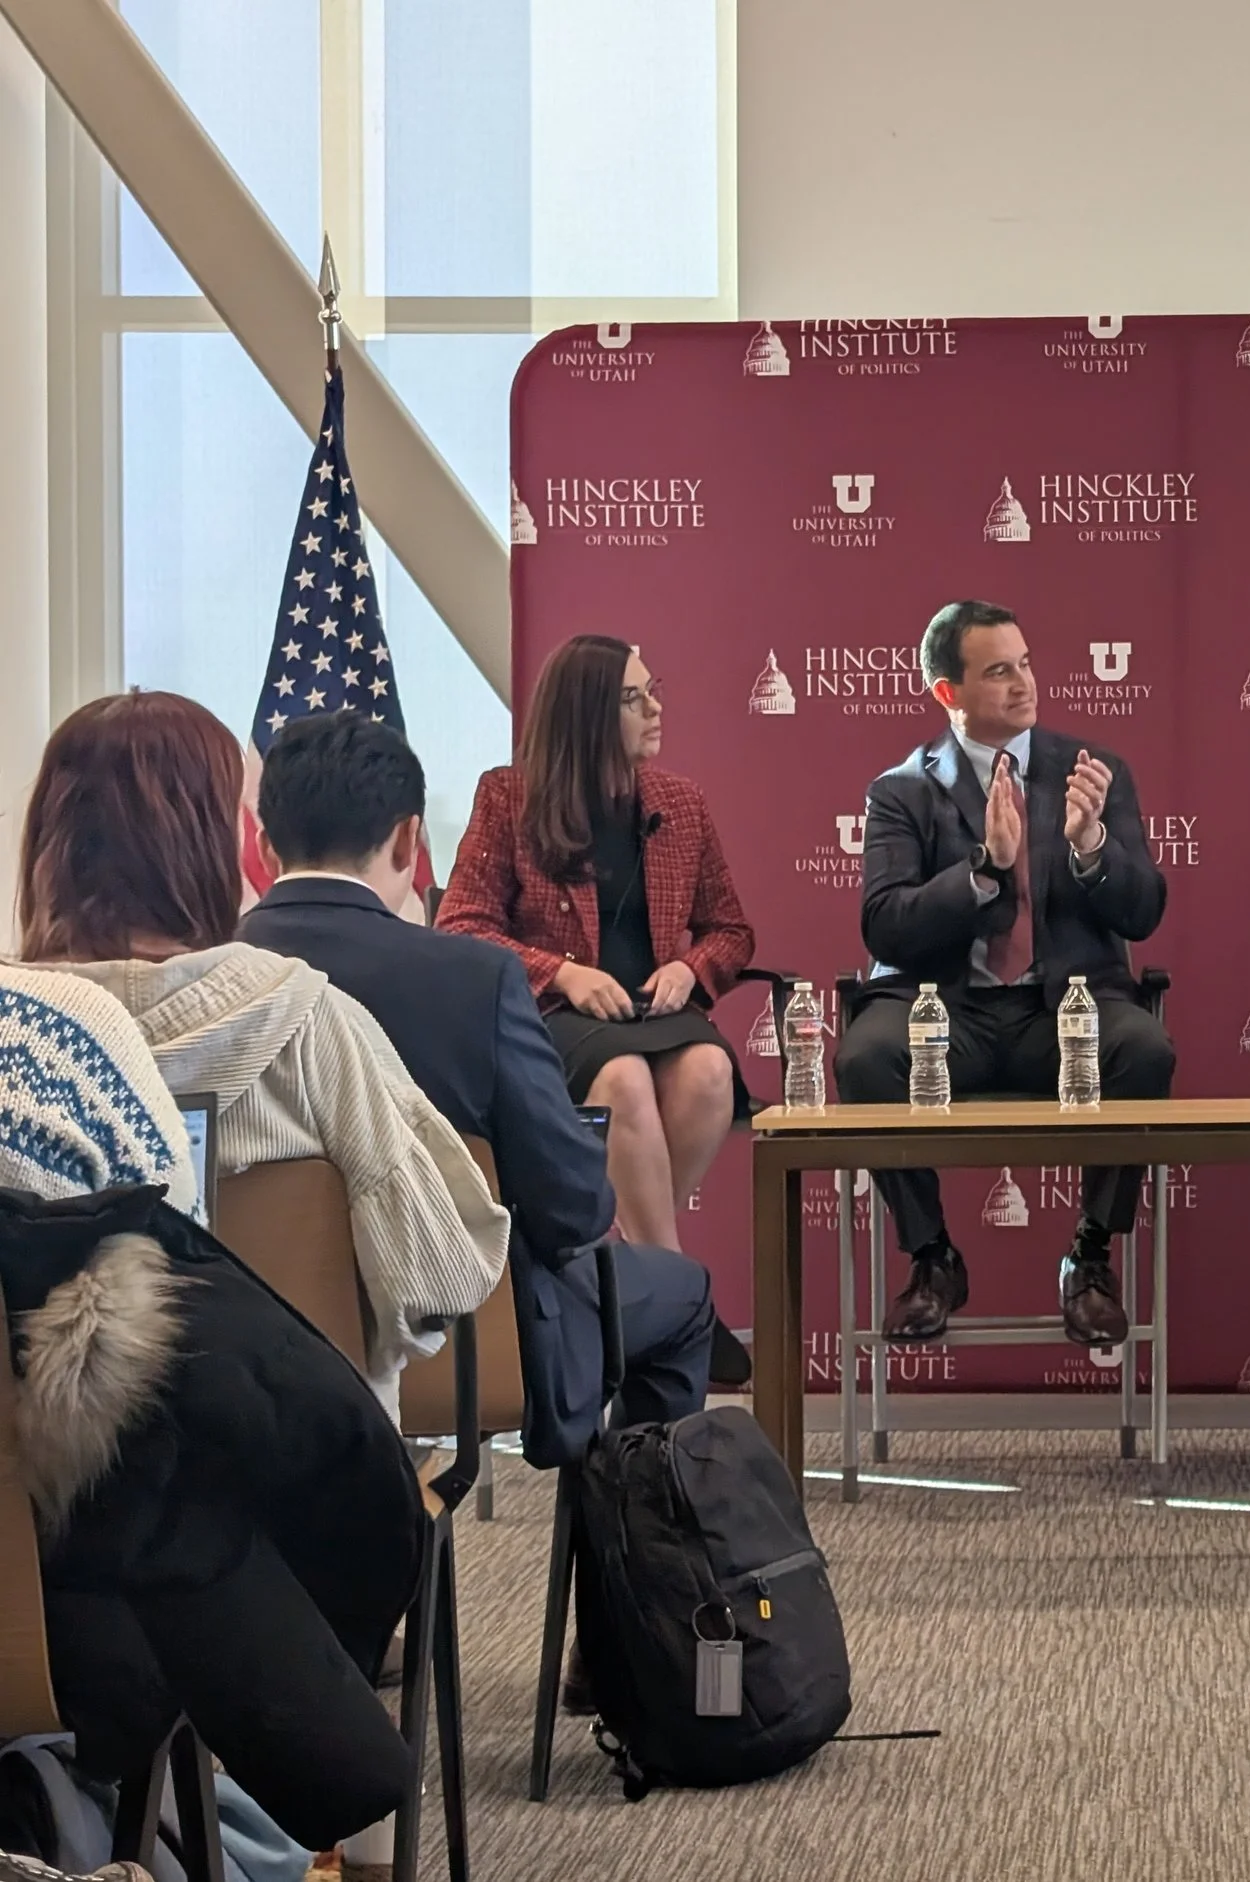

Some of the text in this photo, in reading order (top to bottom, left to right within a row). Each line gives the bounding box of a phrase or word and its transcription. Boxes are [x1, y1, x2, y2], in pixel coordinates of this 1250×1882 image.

[800, 332, 957, 358] INSTITUTE
[1044, 343, 1148, 357] UNIVERSITY
[552, 352, 656, 366] UNIVERSITY
[837, 363, 921, 375] OF POLITICS
[1063, 360, 1129, 374] OF UTAH
[571, 369, 636, 382] OF UTAH
[546, 478, 702, 502] HINCKLEY
[1040, 473, 1196, 498] HINCKLEY
[832, 474, 875, 513] U
[547, 504, 706, 527] INSTITUTE
[1041, 499, 1199, 523] INSTITUTE
[792, 517, 896, 531] UNIVERSITY
[585, 533, 669, 546] OF POLITICS
[812, 533, 877, 548] OF UTAH
[1078, 530, 1162, 542] OF POLITICS
[805, 647, 924, 671] HINCKL
[1089, 642, 1132, 681] U
[806, 672, 926, 697] INSTITU
[1049, 686, 1152, 699] UNIVERSITY
[843, 703, 925, 715] OF POLITICS
[1068, 702, 1133, 716] OF UTAH
[795, 859, 861, 872] UNIVER
[833, 874, 864, 888] UTA
[1044, 1371, 1148, 1385] UNIVERSY
